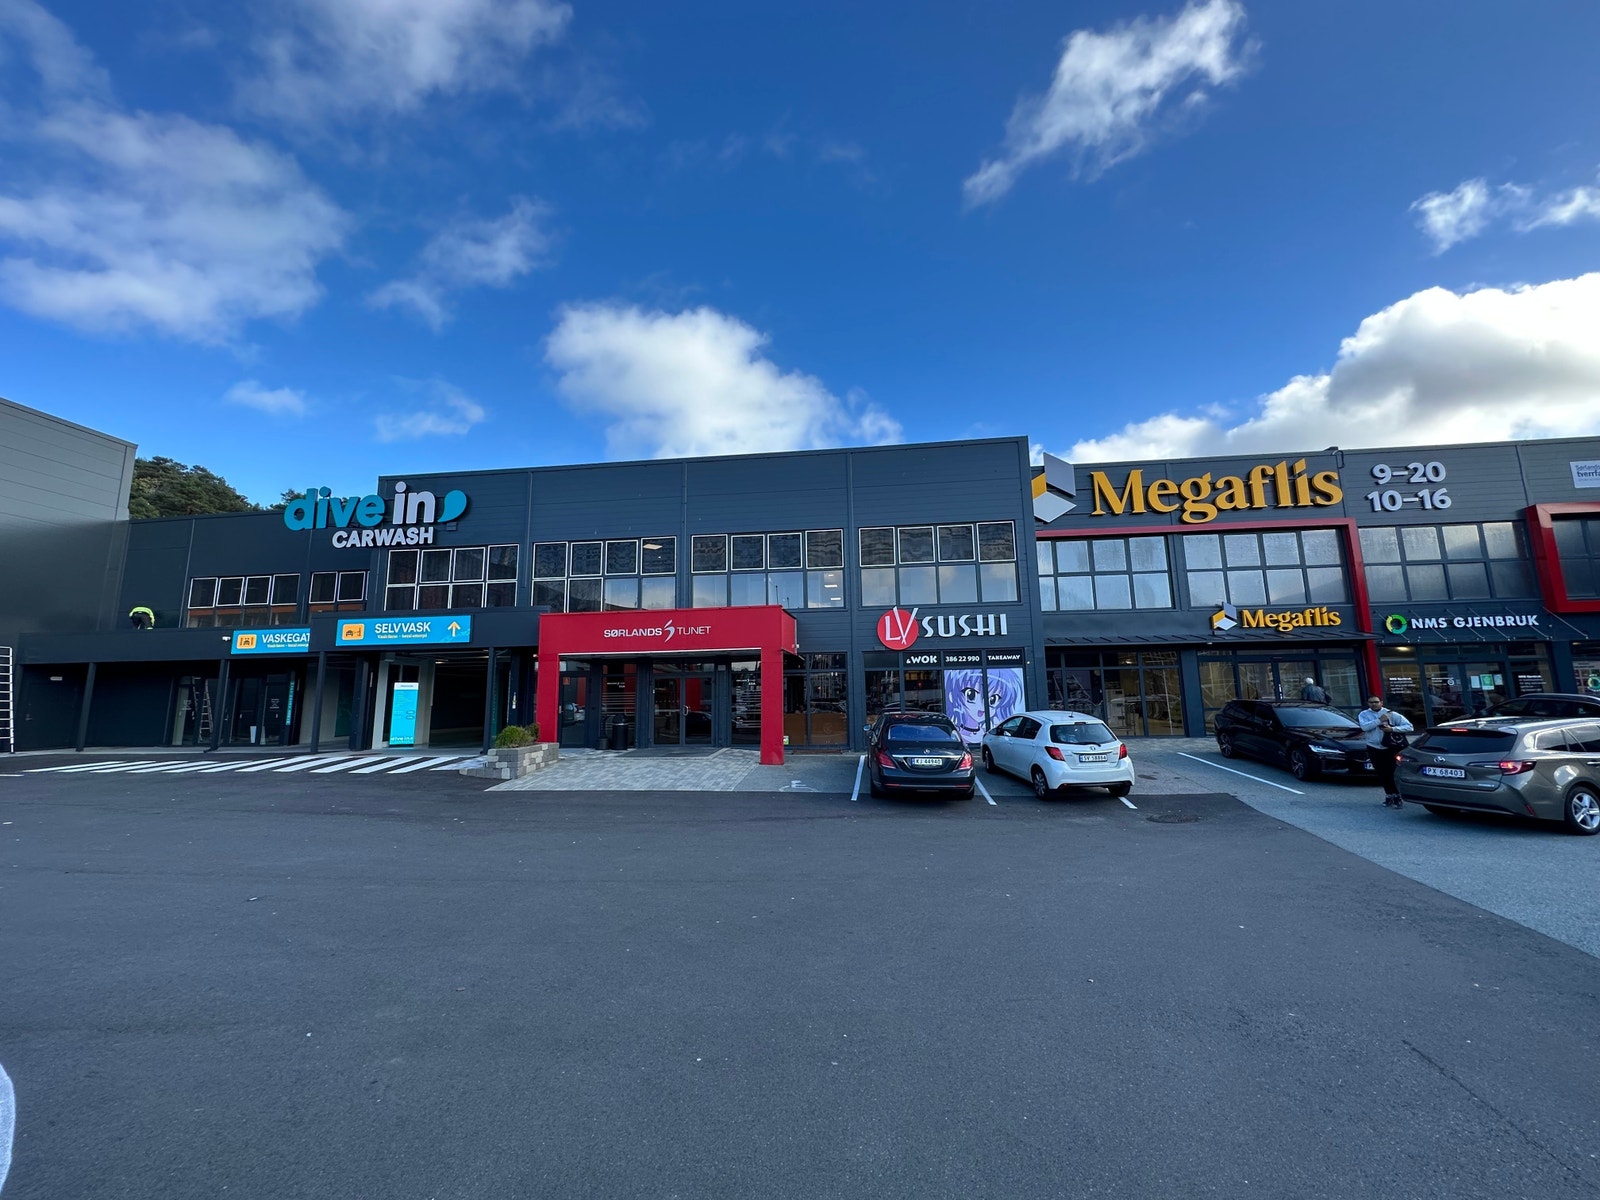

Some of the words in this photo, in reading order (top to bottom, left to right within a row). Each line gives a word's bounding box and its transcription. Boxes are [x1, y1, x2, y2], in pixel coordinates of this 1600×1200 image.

[1090, 458, 1344, 524] Megaflis
[283, 486, 386, 531] dive
[392, 481, 436, 525] in
[332, 526, 434, 549] CARWASH
[375, 621, 431, 634] SELVVASK
[921, 613, 1008, 638] SUSHI
[1241, 606, 1342, 632] Megaflis
[1411, 617, 1448, 629] NMS
[1453, 614, 1539, 628] GJENBRUK
[603, 627, 663, 638] SØRLANDS
[676, 625, 712, 636] TUNET
[1427, 766, 1437, 774] PX
[1439, 768, 1463, 777] 68403
